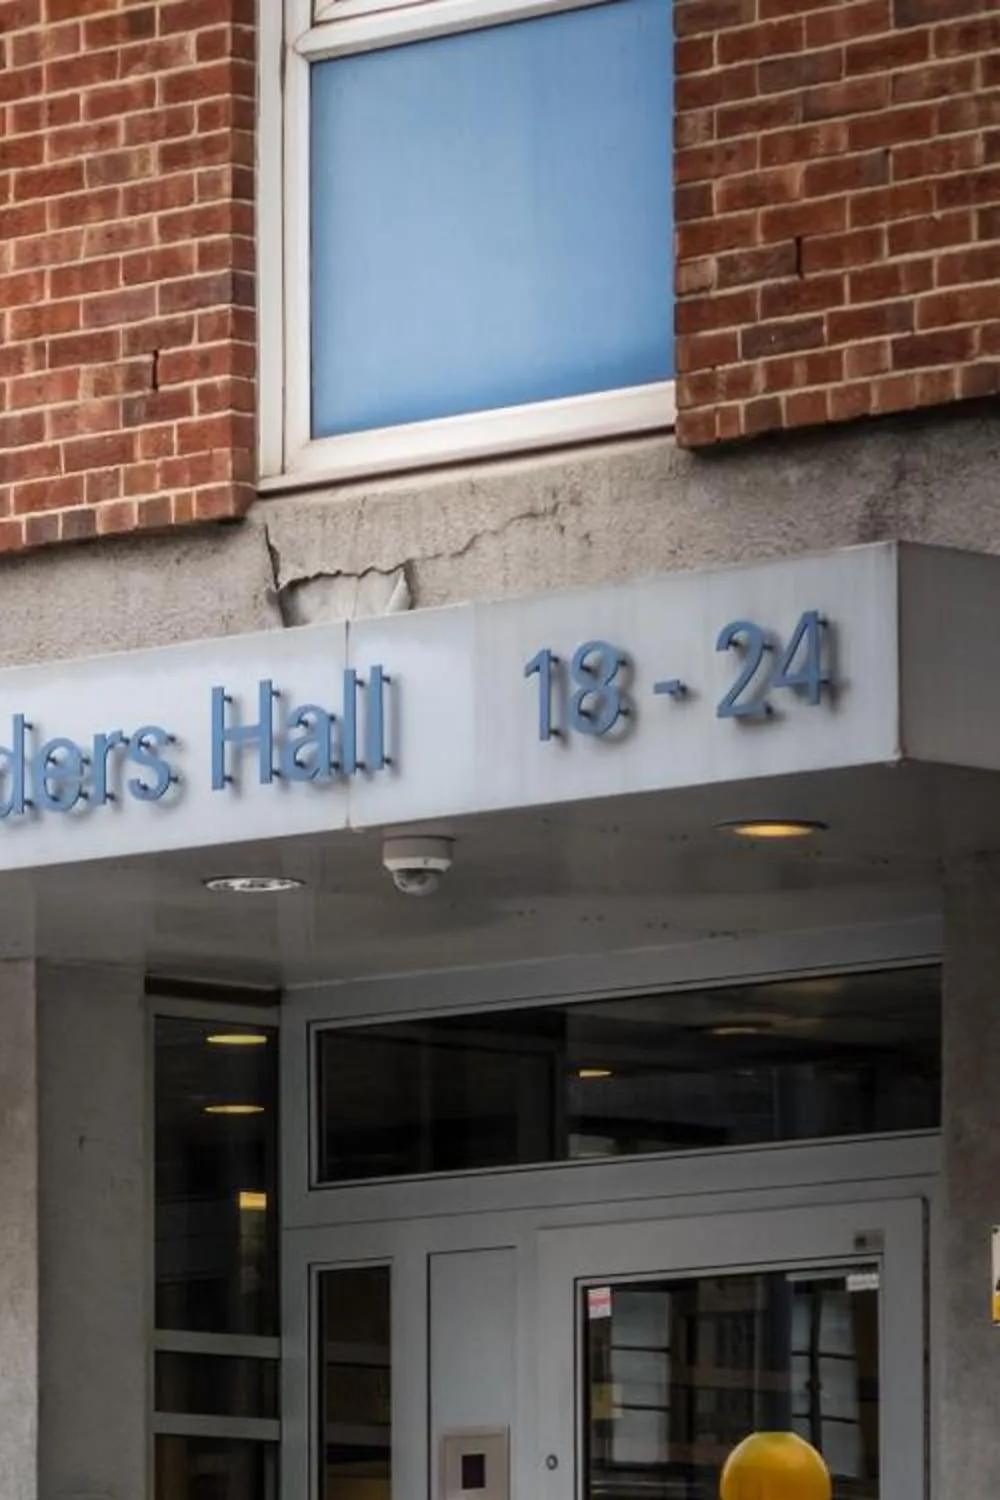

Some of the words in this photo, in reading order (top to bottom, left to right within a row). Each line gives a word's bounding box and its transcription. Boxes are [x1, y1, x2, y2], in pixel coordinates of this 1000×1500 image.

[211, 664, 386, 791] Hall
[524, 648, 622, 742] 18
[715, 610, 822, 716] 24
